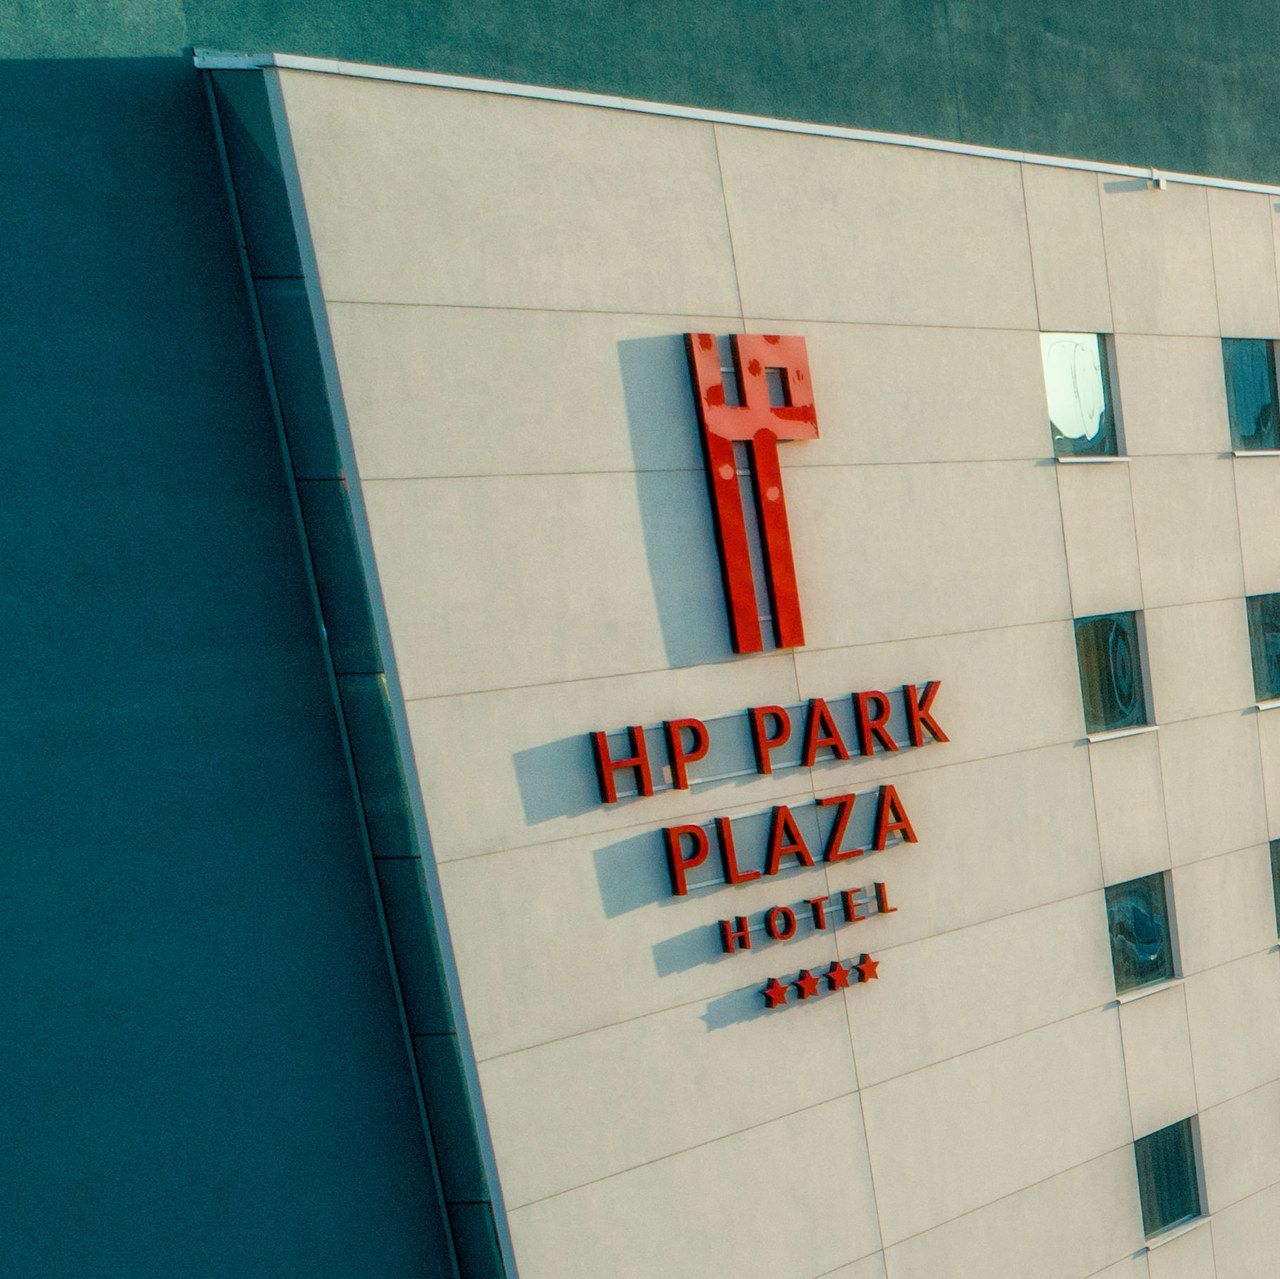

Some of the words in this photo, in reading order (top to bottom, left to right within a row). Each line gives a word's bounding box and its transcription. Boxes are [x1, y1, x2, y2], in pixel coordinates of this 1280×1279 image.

[589, 716, 710, 804] HP
[748, 680, 950, 775] PARK
[662, 784, 918, 896] PLAZA
[718, 882, 899, 954] HOTEL
